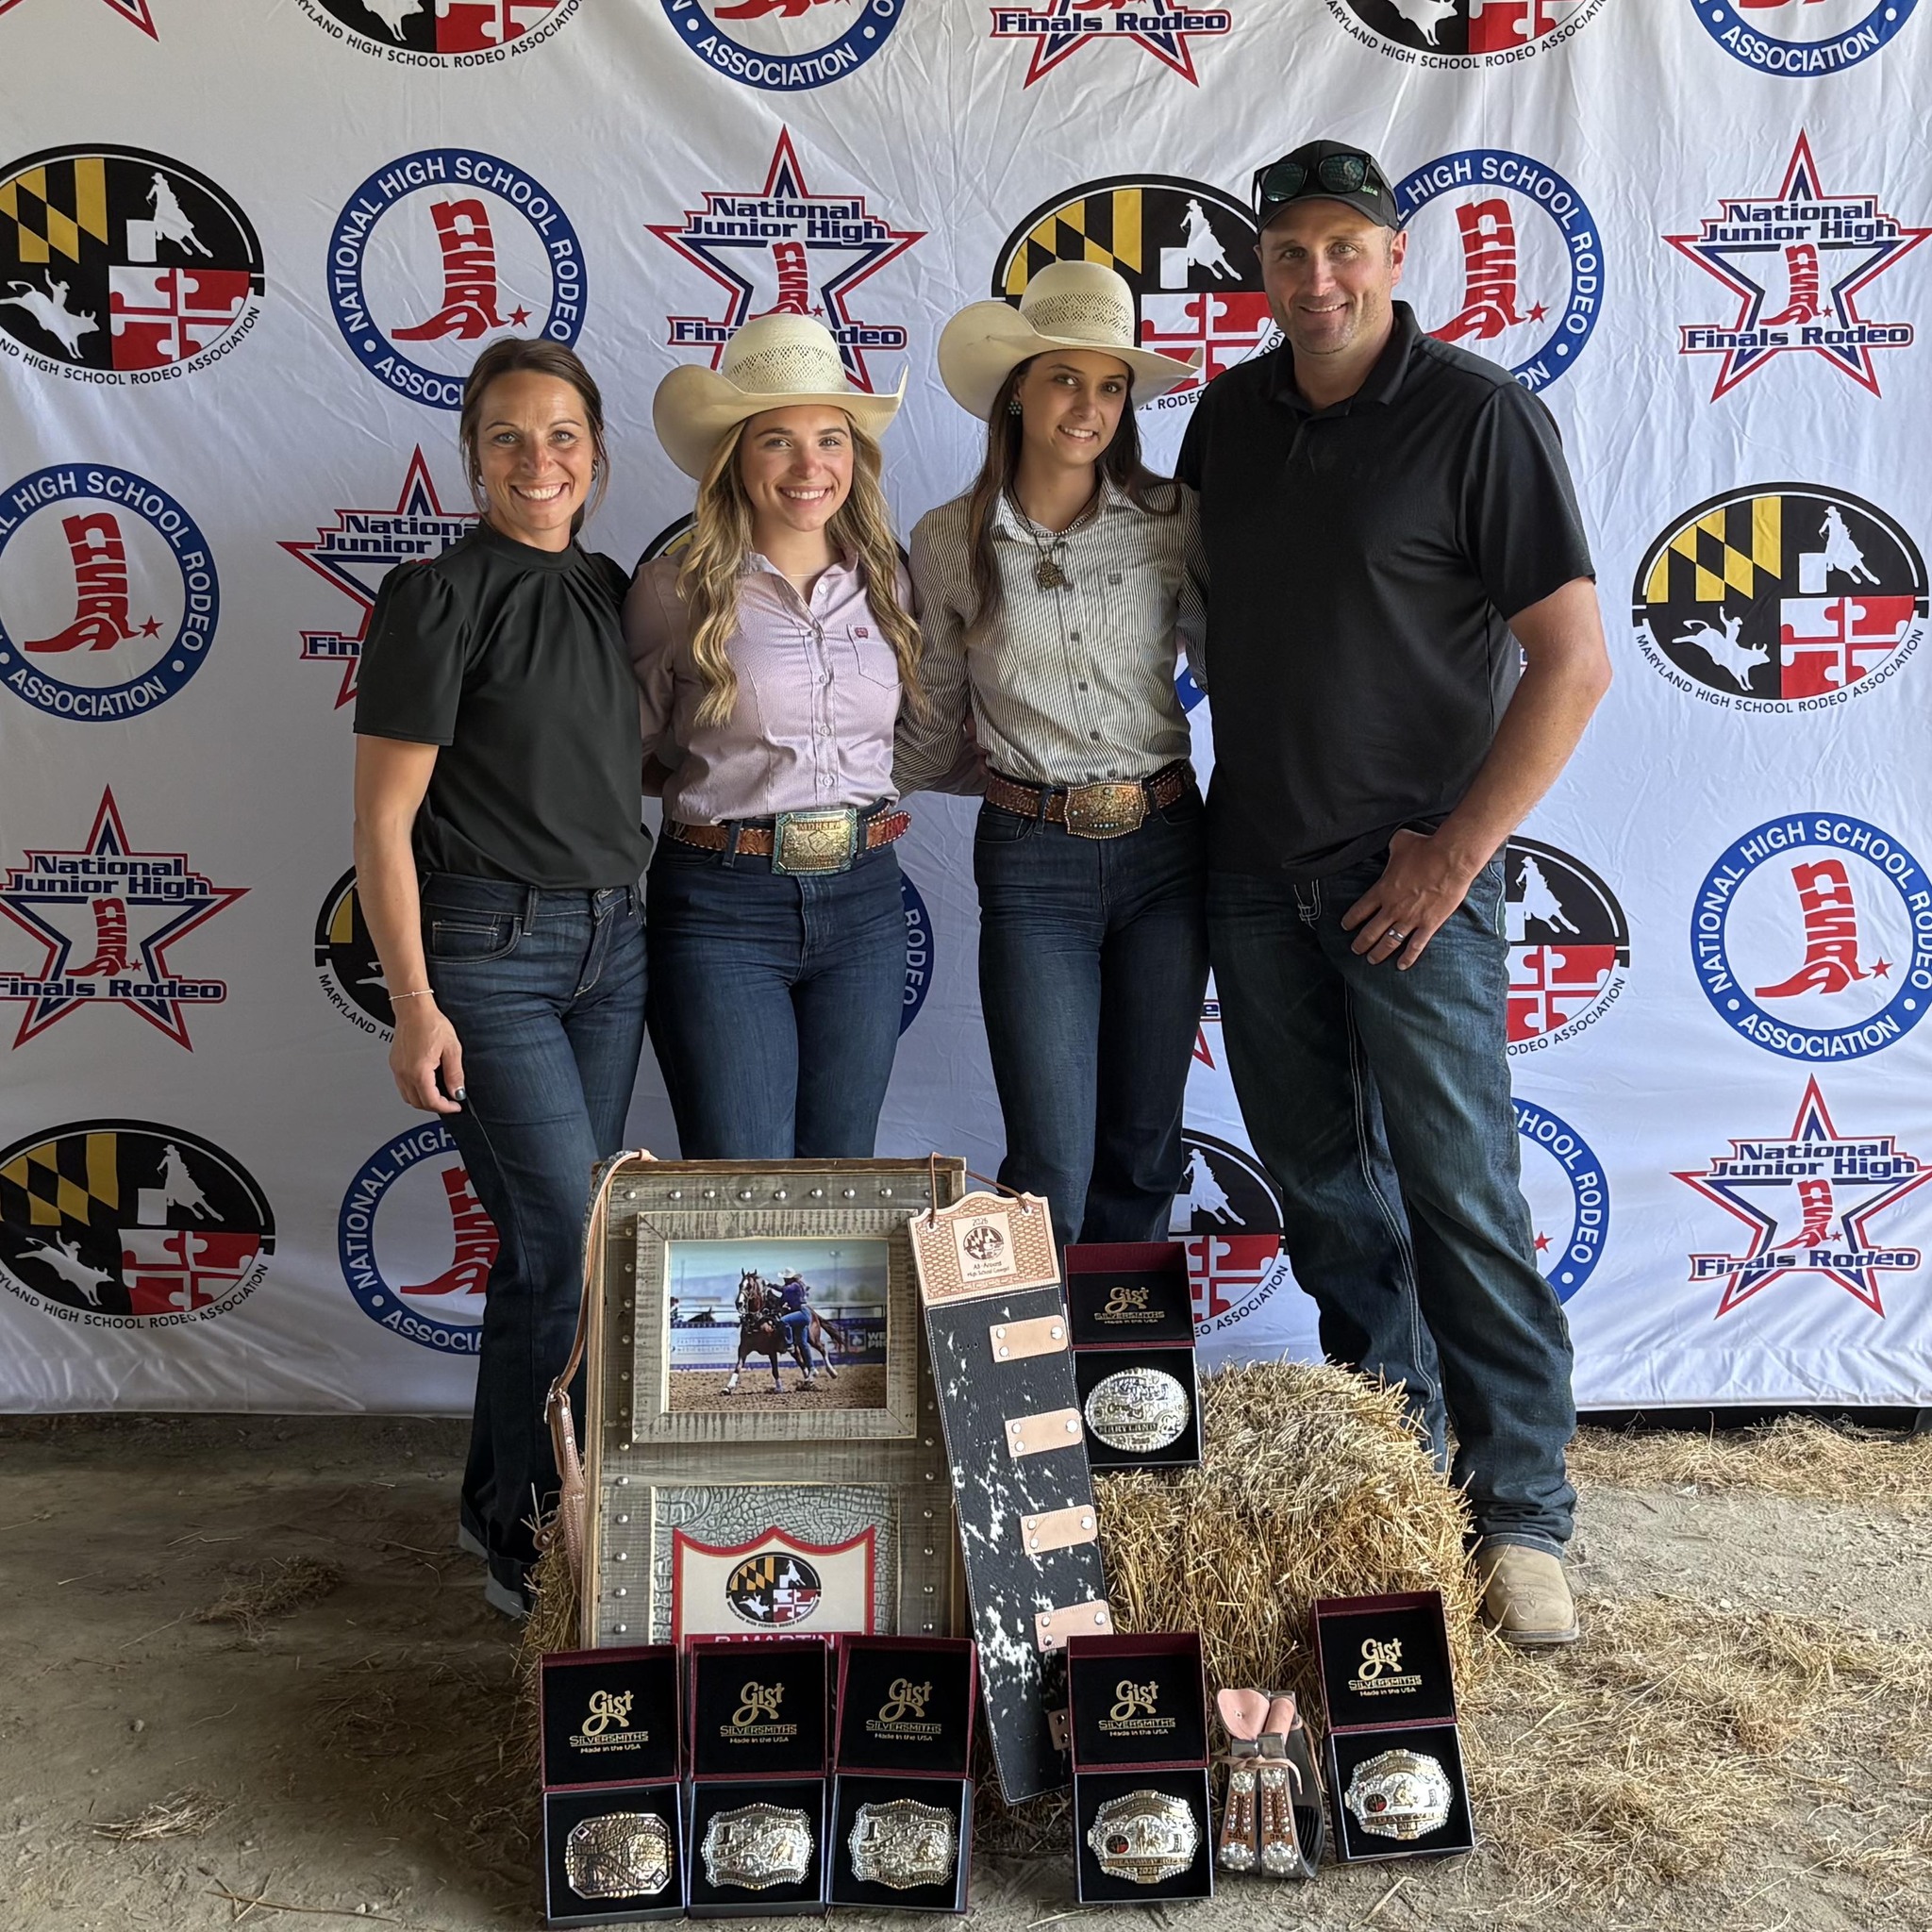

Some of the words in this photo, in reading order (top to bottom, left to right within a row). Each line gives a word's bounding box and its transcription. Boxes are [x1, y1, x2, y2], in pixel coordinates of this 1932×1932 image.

[346, 34, 382, 58] HIGH
[388, 49, 449, 68] SCHOOL
[454, 49, 506, 68] RODEO
[510, 0, 583, 57] ASSOCIATIO
[998, 13, 1103, 32] Finals
[1116, 12, 1226, 31] Rodeo
[1327, 0, 1378, 49] ARYLAND
[1381, 44, 1417, 64] HIGH
[1420, 55, 1480, 70] SCHOOL
[1485, 46, 1536, 68] RODEO
[1541, 0, 1607, 52] ASSOCIATI
[696, 35, 859, 87] ASSOCIATION
[1721, 25, 1880, 72] ASSOCIATION
[684, 216, 798, 238] Junior
[808, 219, 885, 243] High
[712, 197, 860, 220] National
[1728, 201, 1873, 223] National
[335, 197, 384, 333] NATIONAL
[377, 157, 447, 199] HIGH
[454, 157, 558, 237] SCHOOL
[549, 238, 580, 341] RODEO
[1406, 158, 1472, 205] HIGH
[1481, 157, 1580, 230] SCHOOL
[1571, 231, 1597, 335] RODEO
[1700, 223, 1811, 242] Junior
[1820, 219, 1896, 242] High
[23, 352, 60, 376] HIGH
[64, 367, 126, 386] SCHOOL
[130, 366, 183, 386] RODEO
[187, 306, 261, 374] ASSOCIATION
[675, 322, 741, 342] Fin
[836, 325, 902, 345] deo
[1688, 328, 1789, 348] Finals
[1801, 325, 1909, 345] Rodeo
[374, 356, 464, 406] ASSOCI
[318, 533, 432, 554] Junior
[345, 515, 478, 536] Nation
[12, 472, 77, 513] HIGH
[86, 472, 190, 549] SCHOOL
[182, 550, 212, 652] RODEO
[308, 637, 360, 655] Fin
[8, 667, 167, 717] ASSOCIATION
[1636, 634, 1692, 693] MARYLAND
[1695, 688, 1730, 708] HIGH
[1735, 699, 1793, 714] SCHOOL
[1799, 691, 1848, 712] RODEO
[1853, 628, 1924, 699] ASSOCIATION
[5, 874, 119, 893] Junior
[128, 876, 208, 899] High
[34, 856, 182, 875] National
[1698, 864, 1746, 994] NATIONAL
[1740, 821, 1807, 865] HIGH
[1814, 819, 1915, 891] SCHOOL
[1908, 890, 1932, 990] RODEO
[109, 979, 222, 998] Rodeo
[319, 974, 376, 1034] MARYLAND
[379, 1029, 394, 1043] HI
[1507, 1038, 1549, 1056] ODEO
[1554, 977, 1625, 1044] ASSOCIATION
[1737, 1012, 1902, 1058] ASSOCIATION
[1709, 1161, 1824, 1176] Junior
[1834, 1158, 1915, 1178] High
[1740, 1141, 1890, 1160] National
[1513, 1105, 1583, 1171] HOOL
[1574, 1171, 1603, 1264] RODEO
[346, 1166, 394, 1291] NATIONAL
[391, 1126, 457, 1167] HIGH
[1697, 1252, 1796, 1276] Finals
[1809, 1250, 1916, 1268] Rodeo
[43, 1303, 79, 1323] HIGH
[84, 1315, 144, 1329] SCHOOL
[199, 1263, 269, 1321] ASSOCIATION
[1104, 1287, 1149, 1313] Gist
[1217, 1265, 1289, 1330] ASSOCIATION
[381, 1309, 482, 1352] ASSOCI
[1357, 1638, 1403, 1680] Gist
[582, 1690, 634, 1736] Gist
[732, 1681, 785, 1727] Gist
[878, 1677, 933, 1723] Gist
[1109, 1680, 1158, 1721] Gist
[569, 1731, 649, 1747] SILVERSMITHS
[720, 1724, 797, 1737] SILVERSMITHS
[866, 1720, 941, 1734] SILVERSMITHS
[1098, 1717, 1176, 1731] SILVERSMITHS
